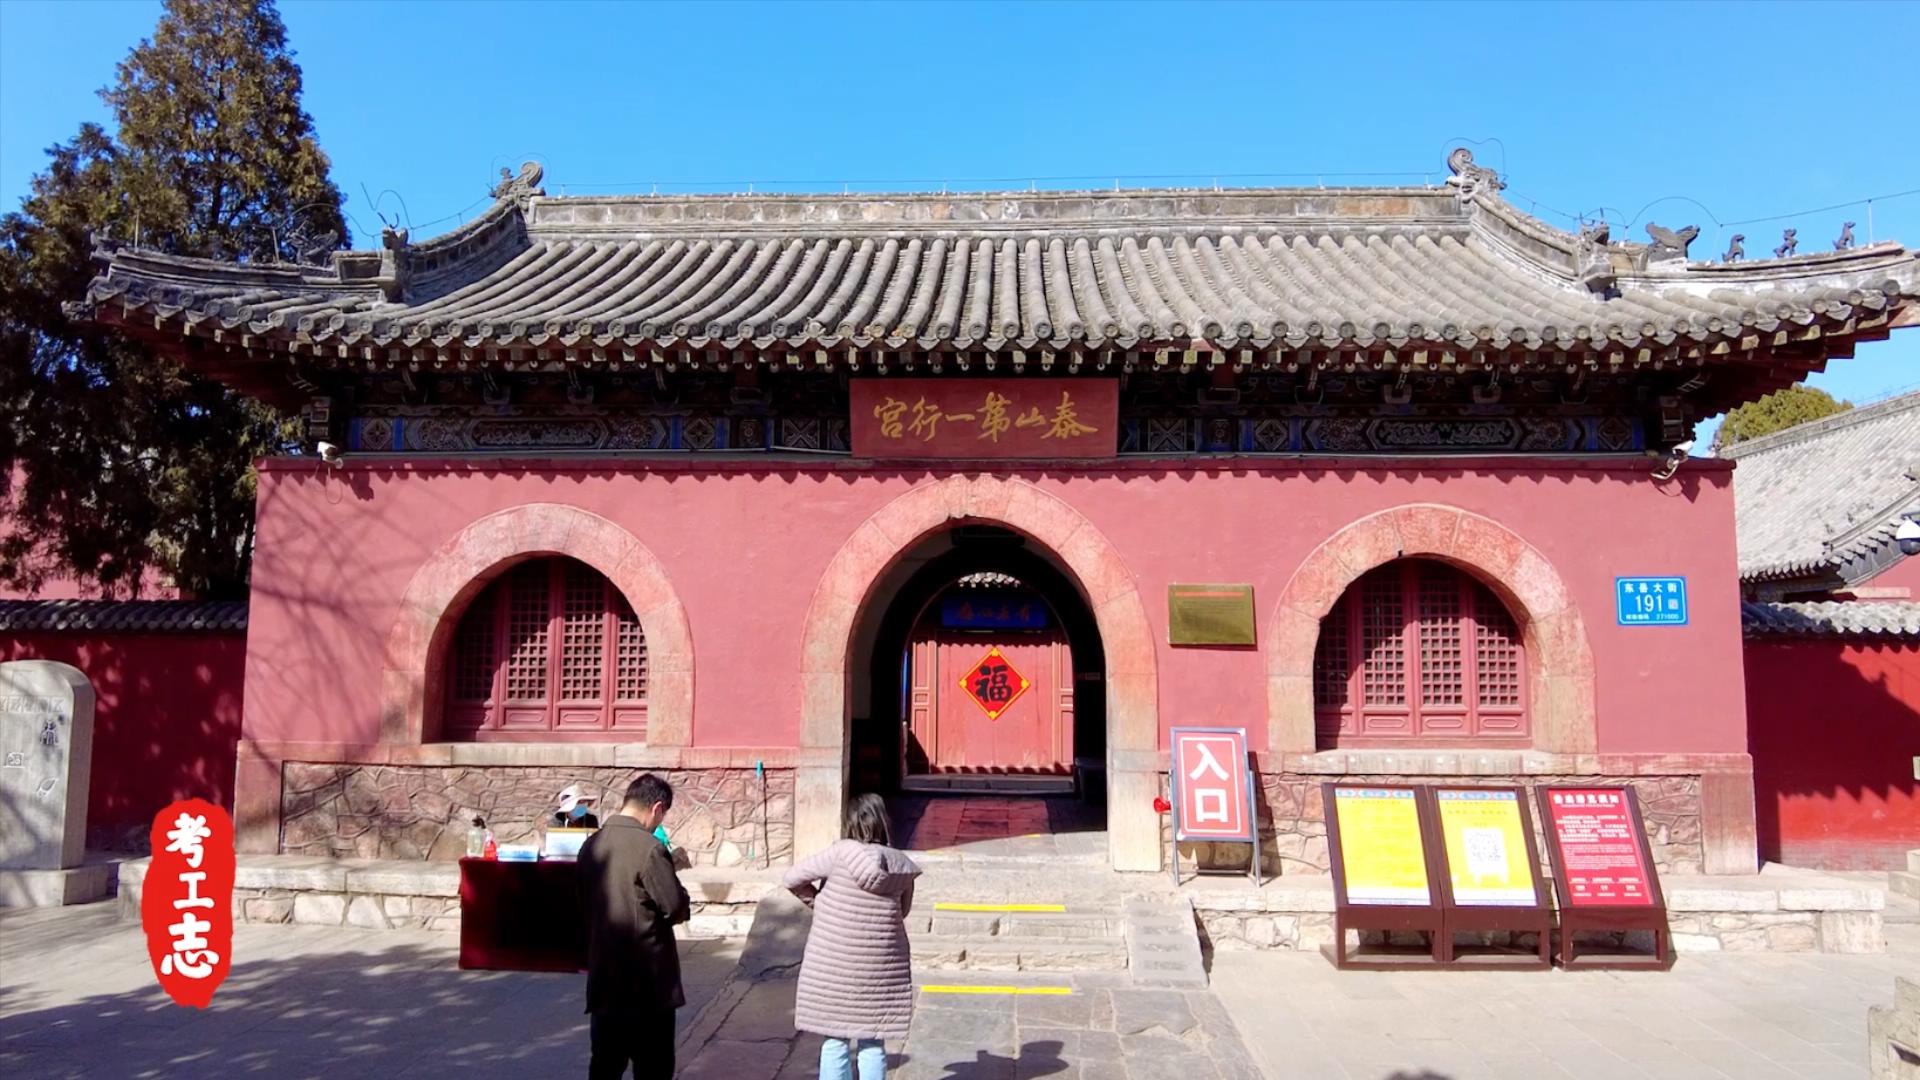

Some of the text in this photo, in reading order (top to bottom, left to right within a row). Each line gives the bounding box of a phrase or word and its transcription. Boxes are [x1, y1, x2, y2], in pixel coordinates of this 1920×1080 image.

[1624, 582, 1677, 593] 东岳大街
[1635, 594, 1662, 612] 191
[975, 665, 1013, 704] 福
[1189, 741, 1230, 824] 入口
